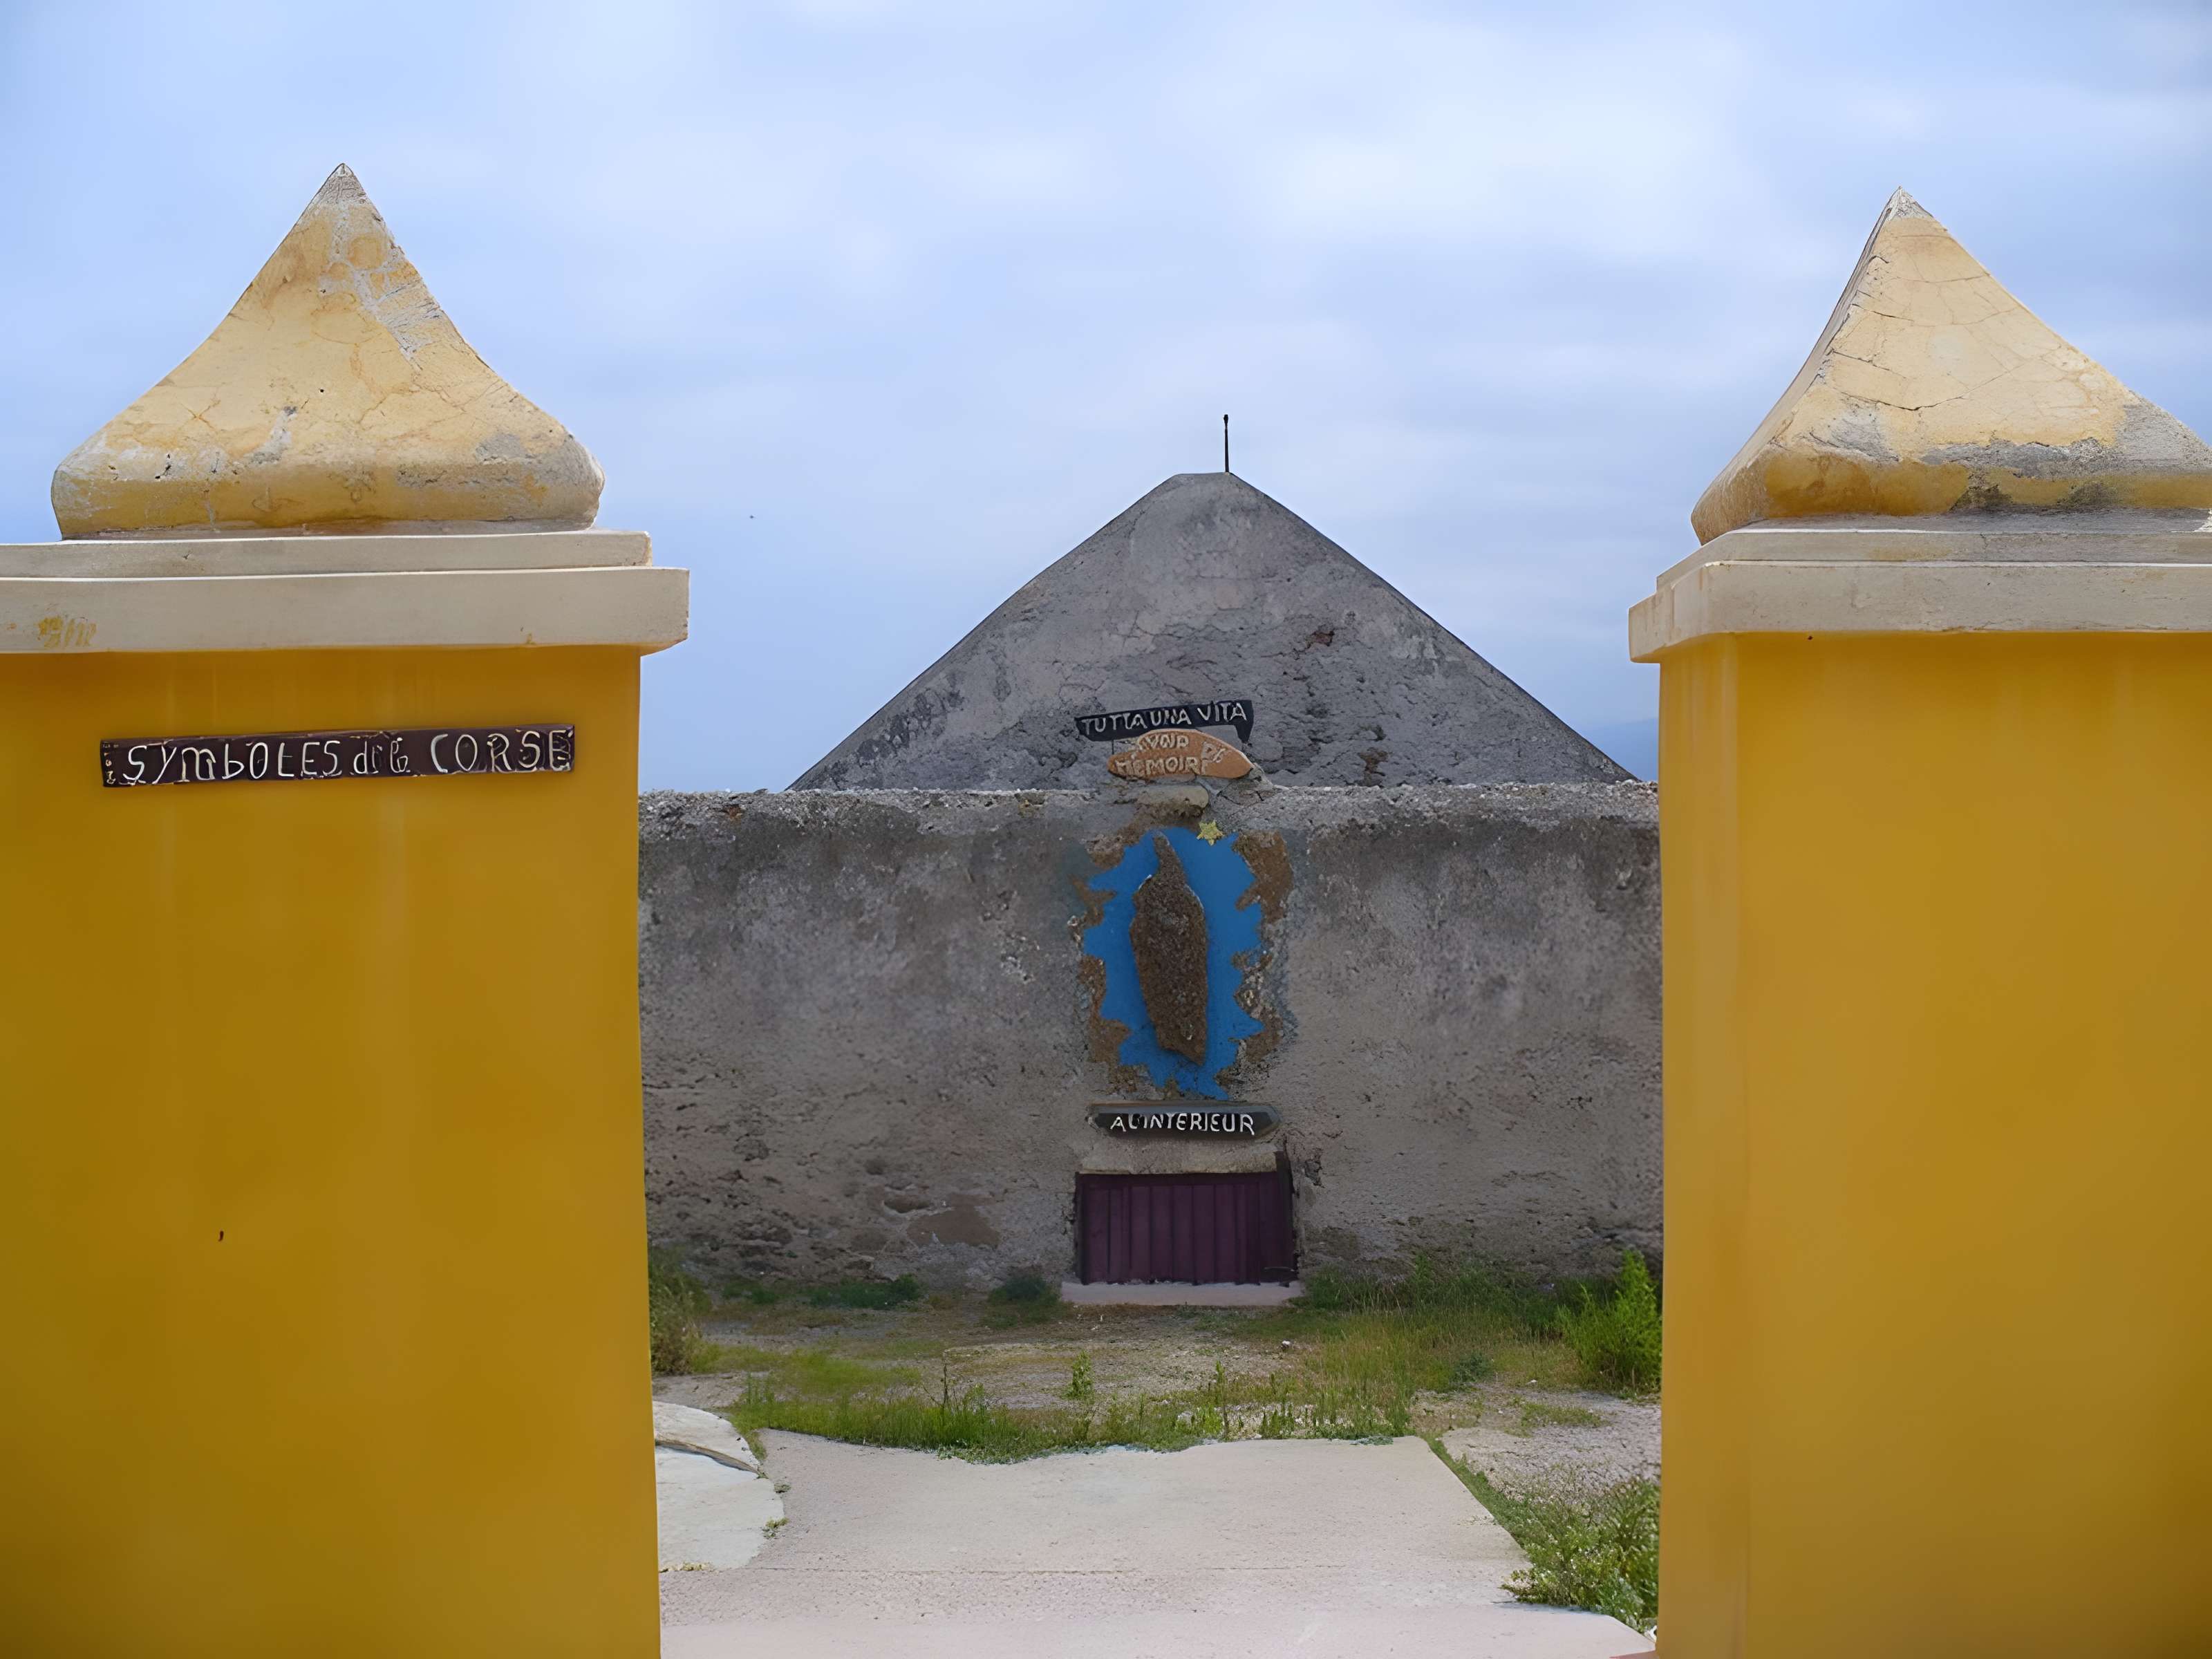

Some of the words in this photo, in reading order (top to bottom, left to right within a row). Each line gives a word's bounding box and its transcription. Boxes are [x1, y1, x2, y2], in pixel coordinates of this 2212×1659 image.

[1081, 713, 1147, 735] TUTTA
[1150, 708, 1192, 726] UNA
[1197, 702, 1247, 722] VITA
[430, 729, 572, 774] CORSE
